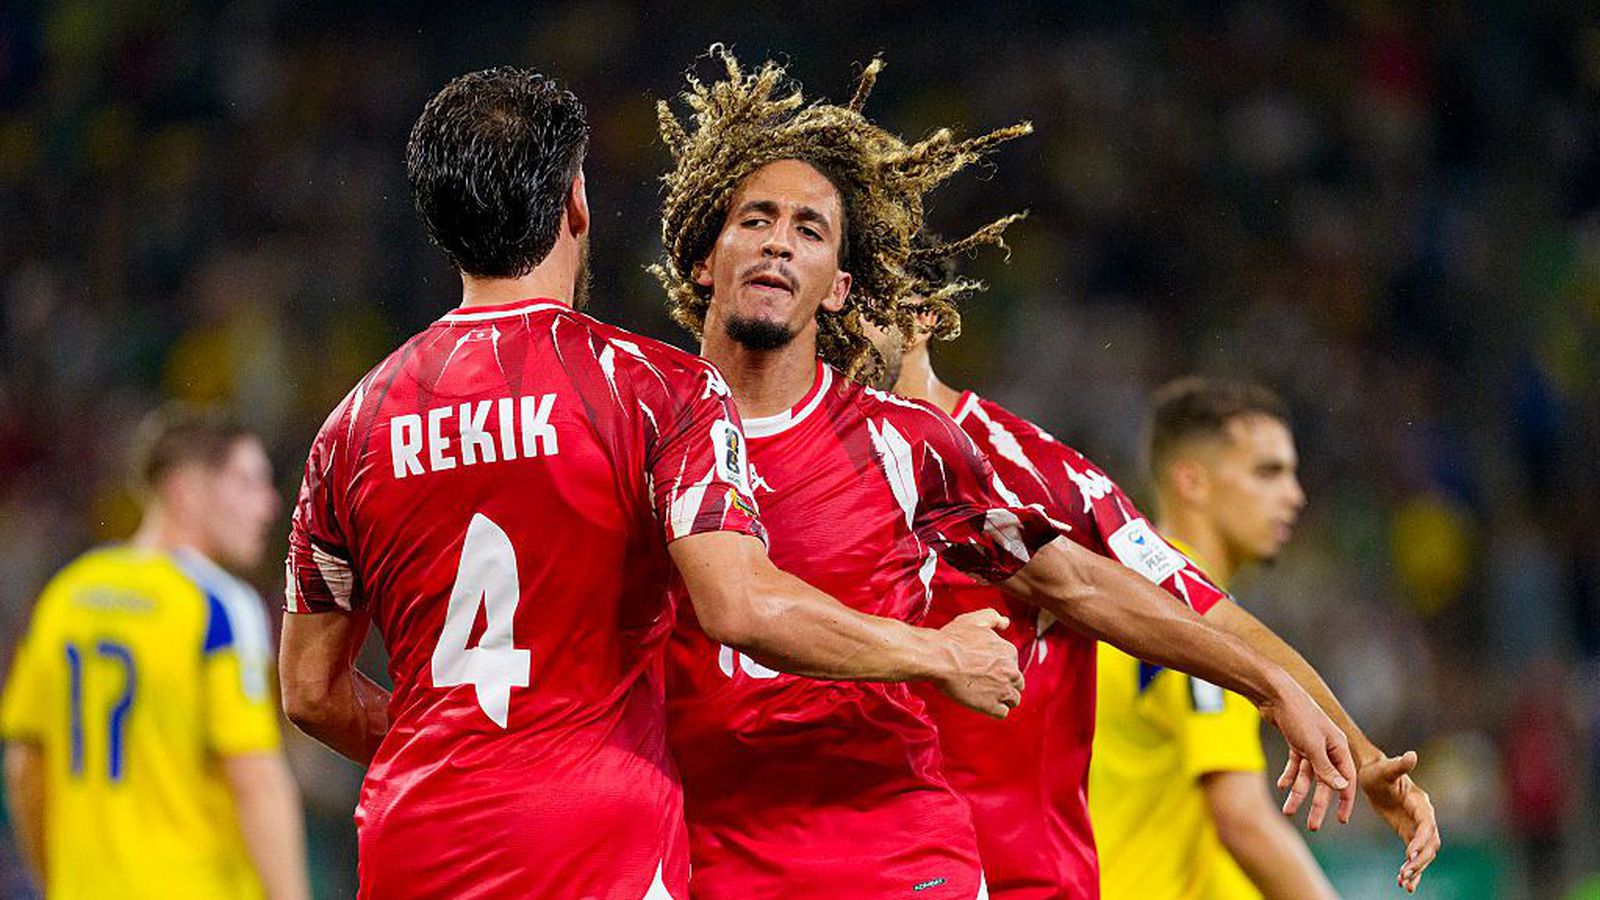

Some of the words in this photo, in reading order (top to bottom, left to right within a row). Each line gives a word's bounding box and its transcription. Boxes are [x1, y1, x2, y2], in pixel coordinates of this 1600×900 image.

[390, 393, 559, 479] REKIK
[431, 512, 531, 729] 4
[65, 640, 137, 783] 17
